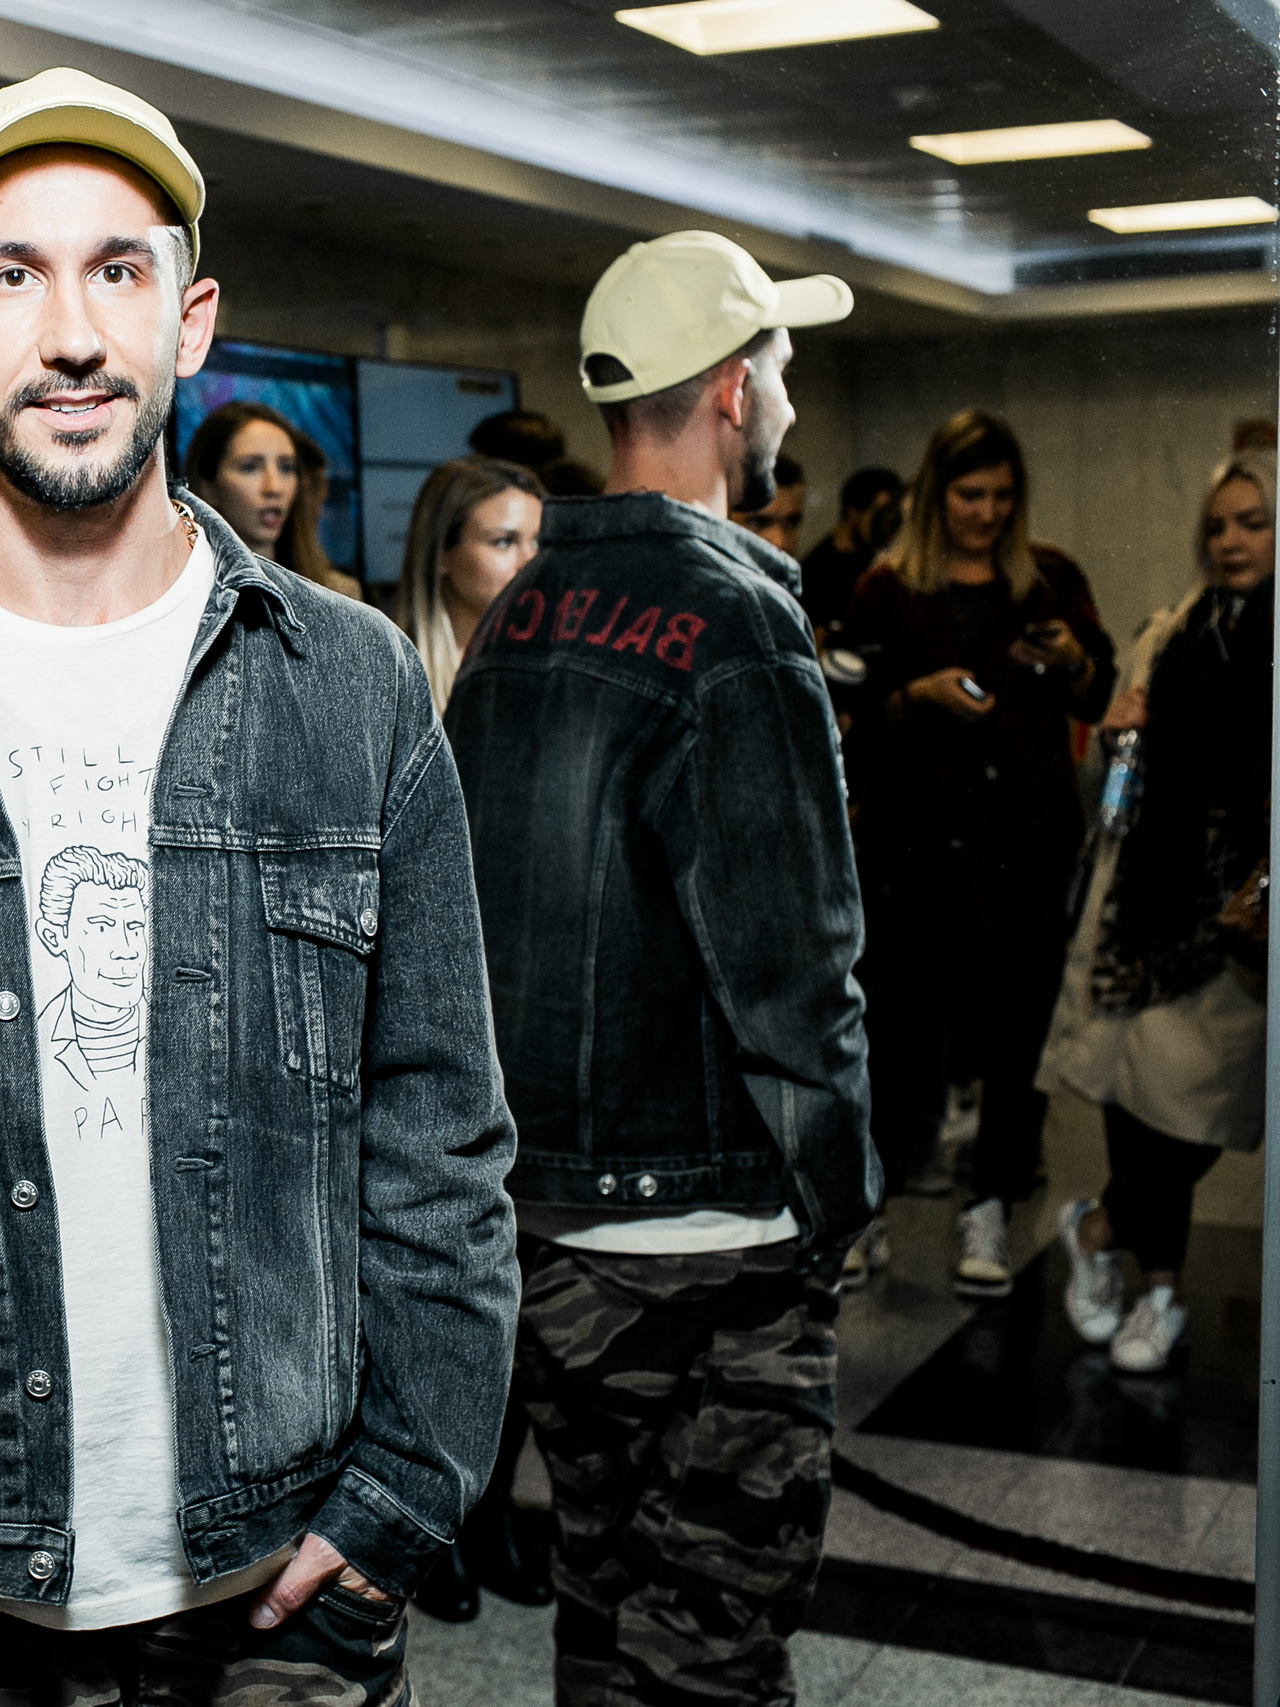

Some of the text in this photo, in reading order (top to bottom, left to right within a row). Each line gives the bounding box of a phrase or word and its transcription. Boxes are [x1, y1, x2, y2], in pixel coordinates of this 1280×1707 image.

[8, 744, 136, 779] STILL
[49, 767, 157, 796] FIGHT
[50, 808, 150, 833] RIGH
